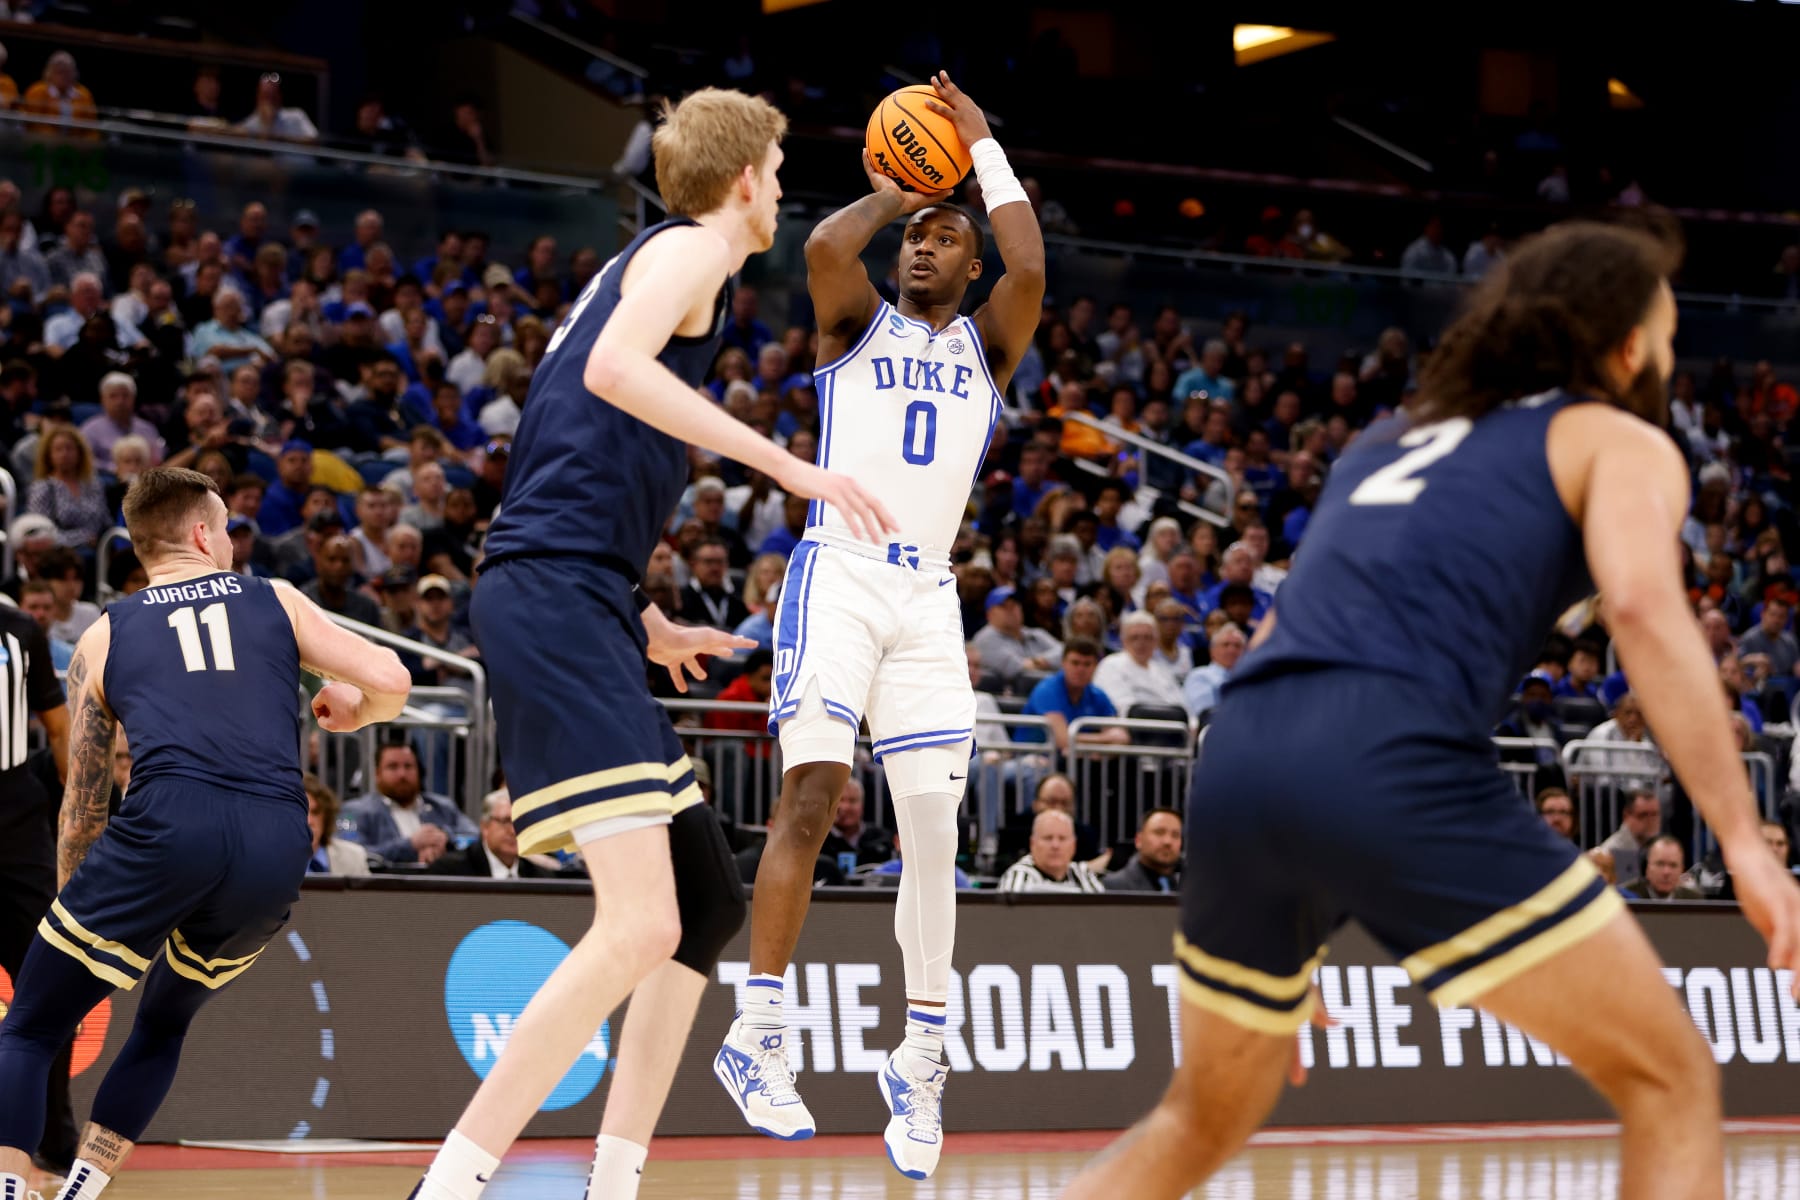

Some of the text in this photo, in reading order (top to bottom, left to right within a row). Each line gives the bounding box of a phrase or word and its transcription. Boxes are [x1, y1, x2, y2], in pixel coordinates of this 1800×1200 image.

[892, 119, 945, 184] Wilson
[871, 356, 973, 400] DUKE
[902, 400, 937, 466] 0
[1349, 416, 1474, 505] 2
[142, 576, 243, 605] JURGENS
[167, 602, 236, 673] 11
